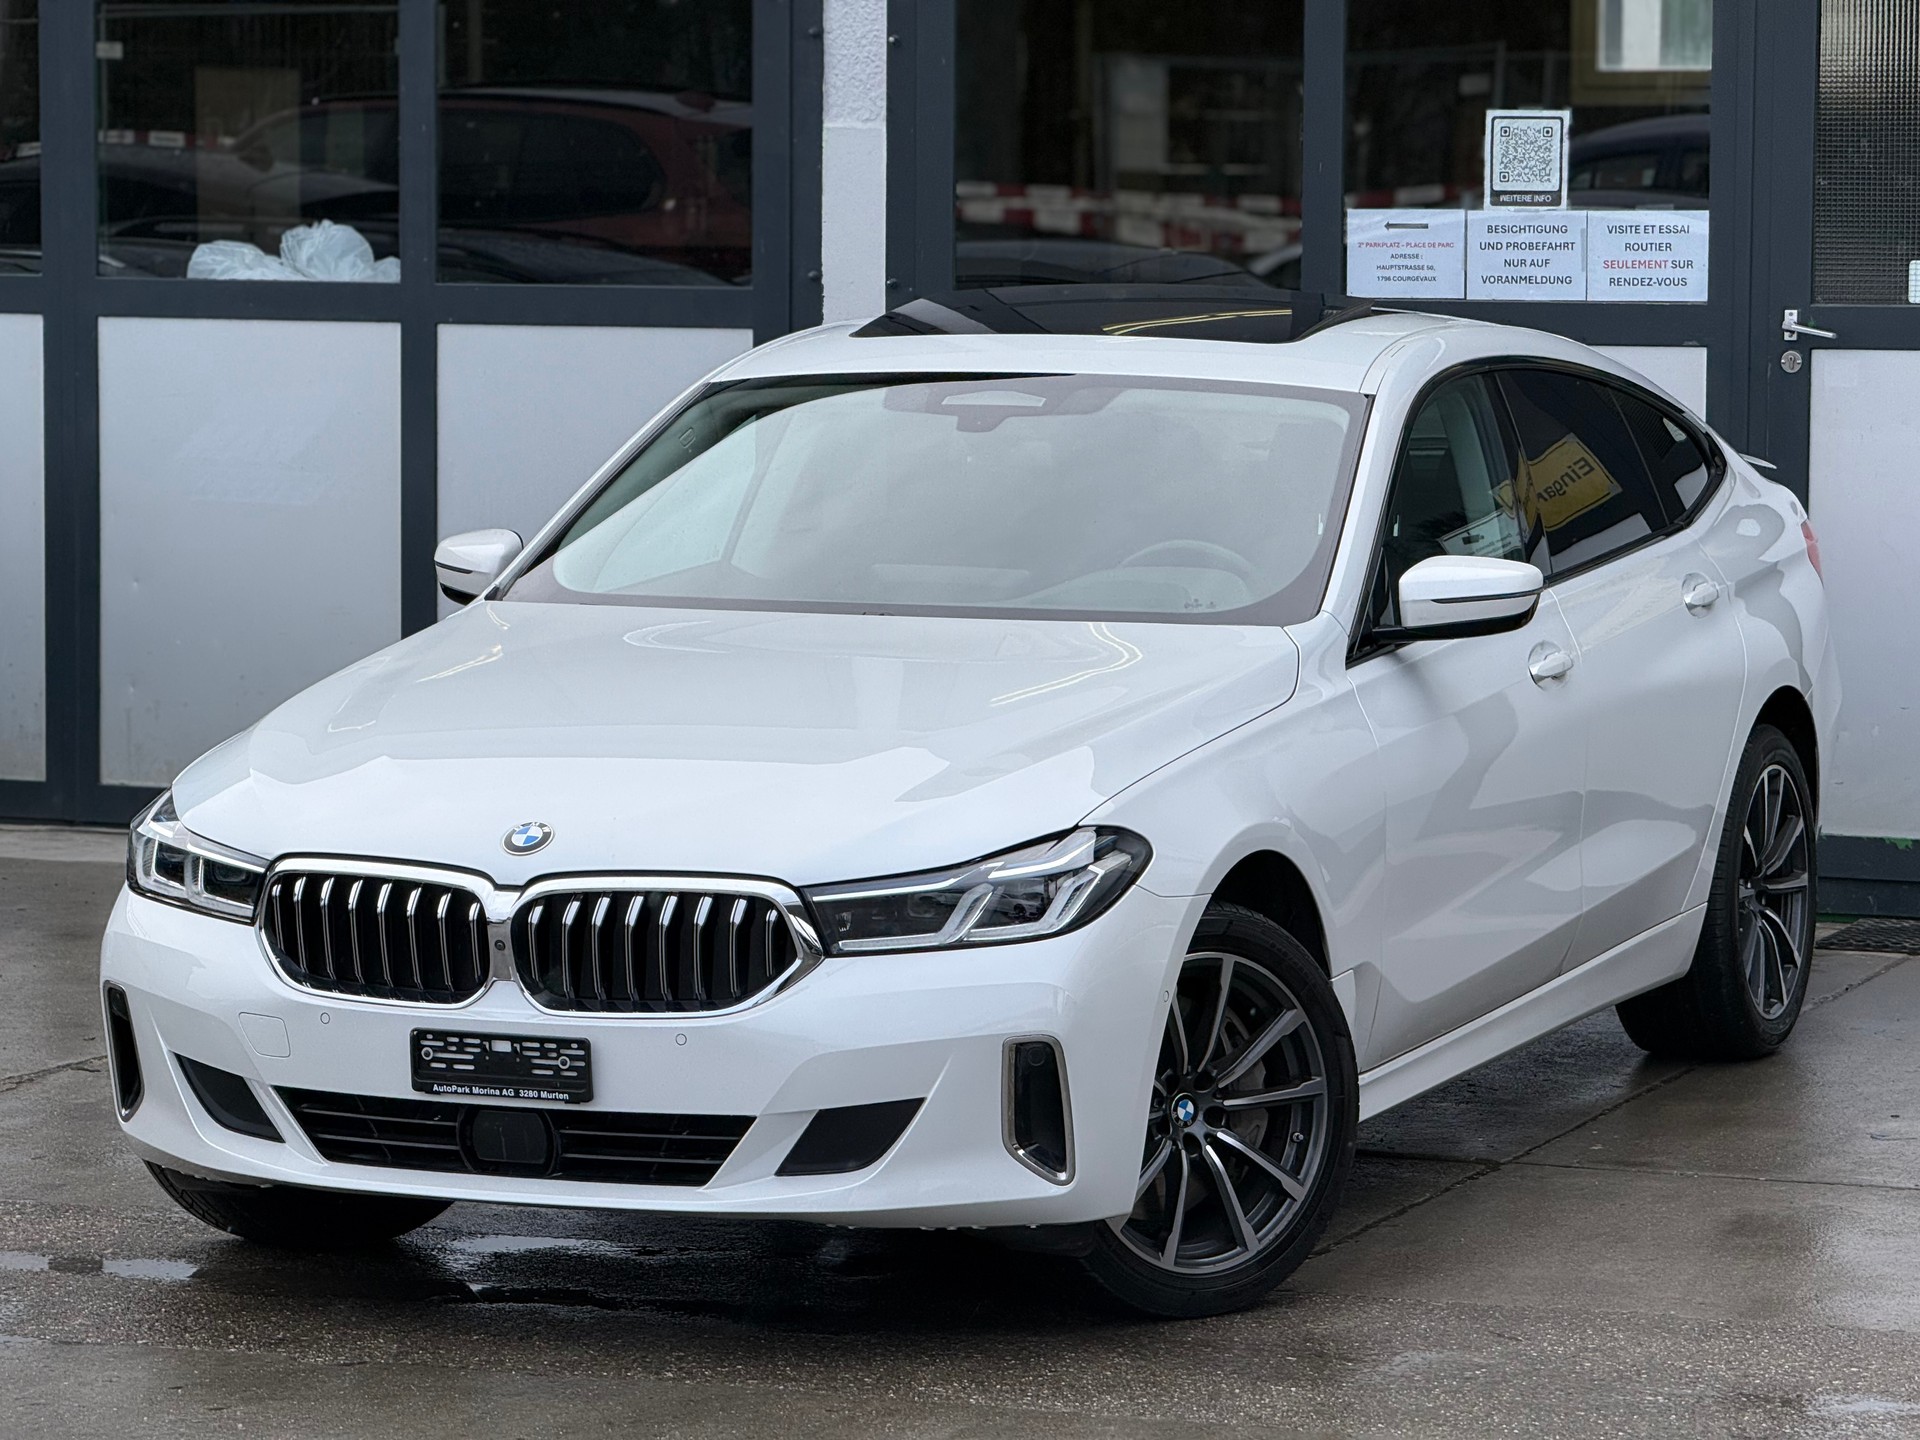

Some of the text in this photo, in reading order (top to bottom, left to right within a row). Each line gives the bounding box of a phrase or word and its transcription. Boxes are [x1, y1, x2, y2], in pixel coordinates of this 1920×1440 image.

[1499, 194, 1552, 203] WEITERE INFO
[1487, 224, 1568, 235] BESICHTIGUNG
[1607, 224, 1690, 235] VISITE ET ESSAI
[1365, 241, 1401, 249] PARKPLATZ
[1405, 241, 1427, 249] PLACE
[1428, 241, 1437, 249] DE
[1438, 241, 1454, 249] PARC
[1479, 241, 1576, 251] UND PROBEFAHRT
[1624, 242, 1673, 252] ROUTIER
[1503, 258, 1551, 268] NUR AUF
[1602, 259, 1694, 270] SEULEMENT SUR
[1481, 275, 1573, 285] VORANMELDUNG
[1609, 276, 1688, 287] RENDEZ-VOUS
[432, 1083, 569, 1100] AutoPark Morina AG 3280 Murten
